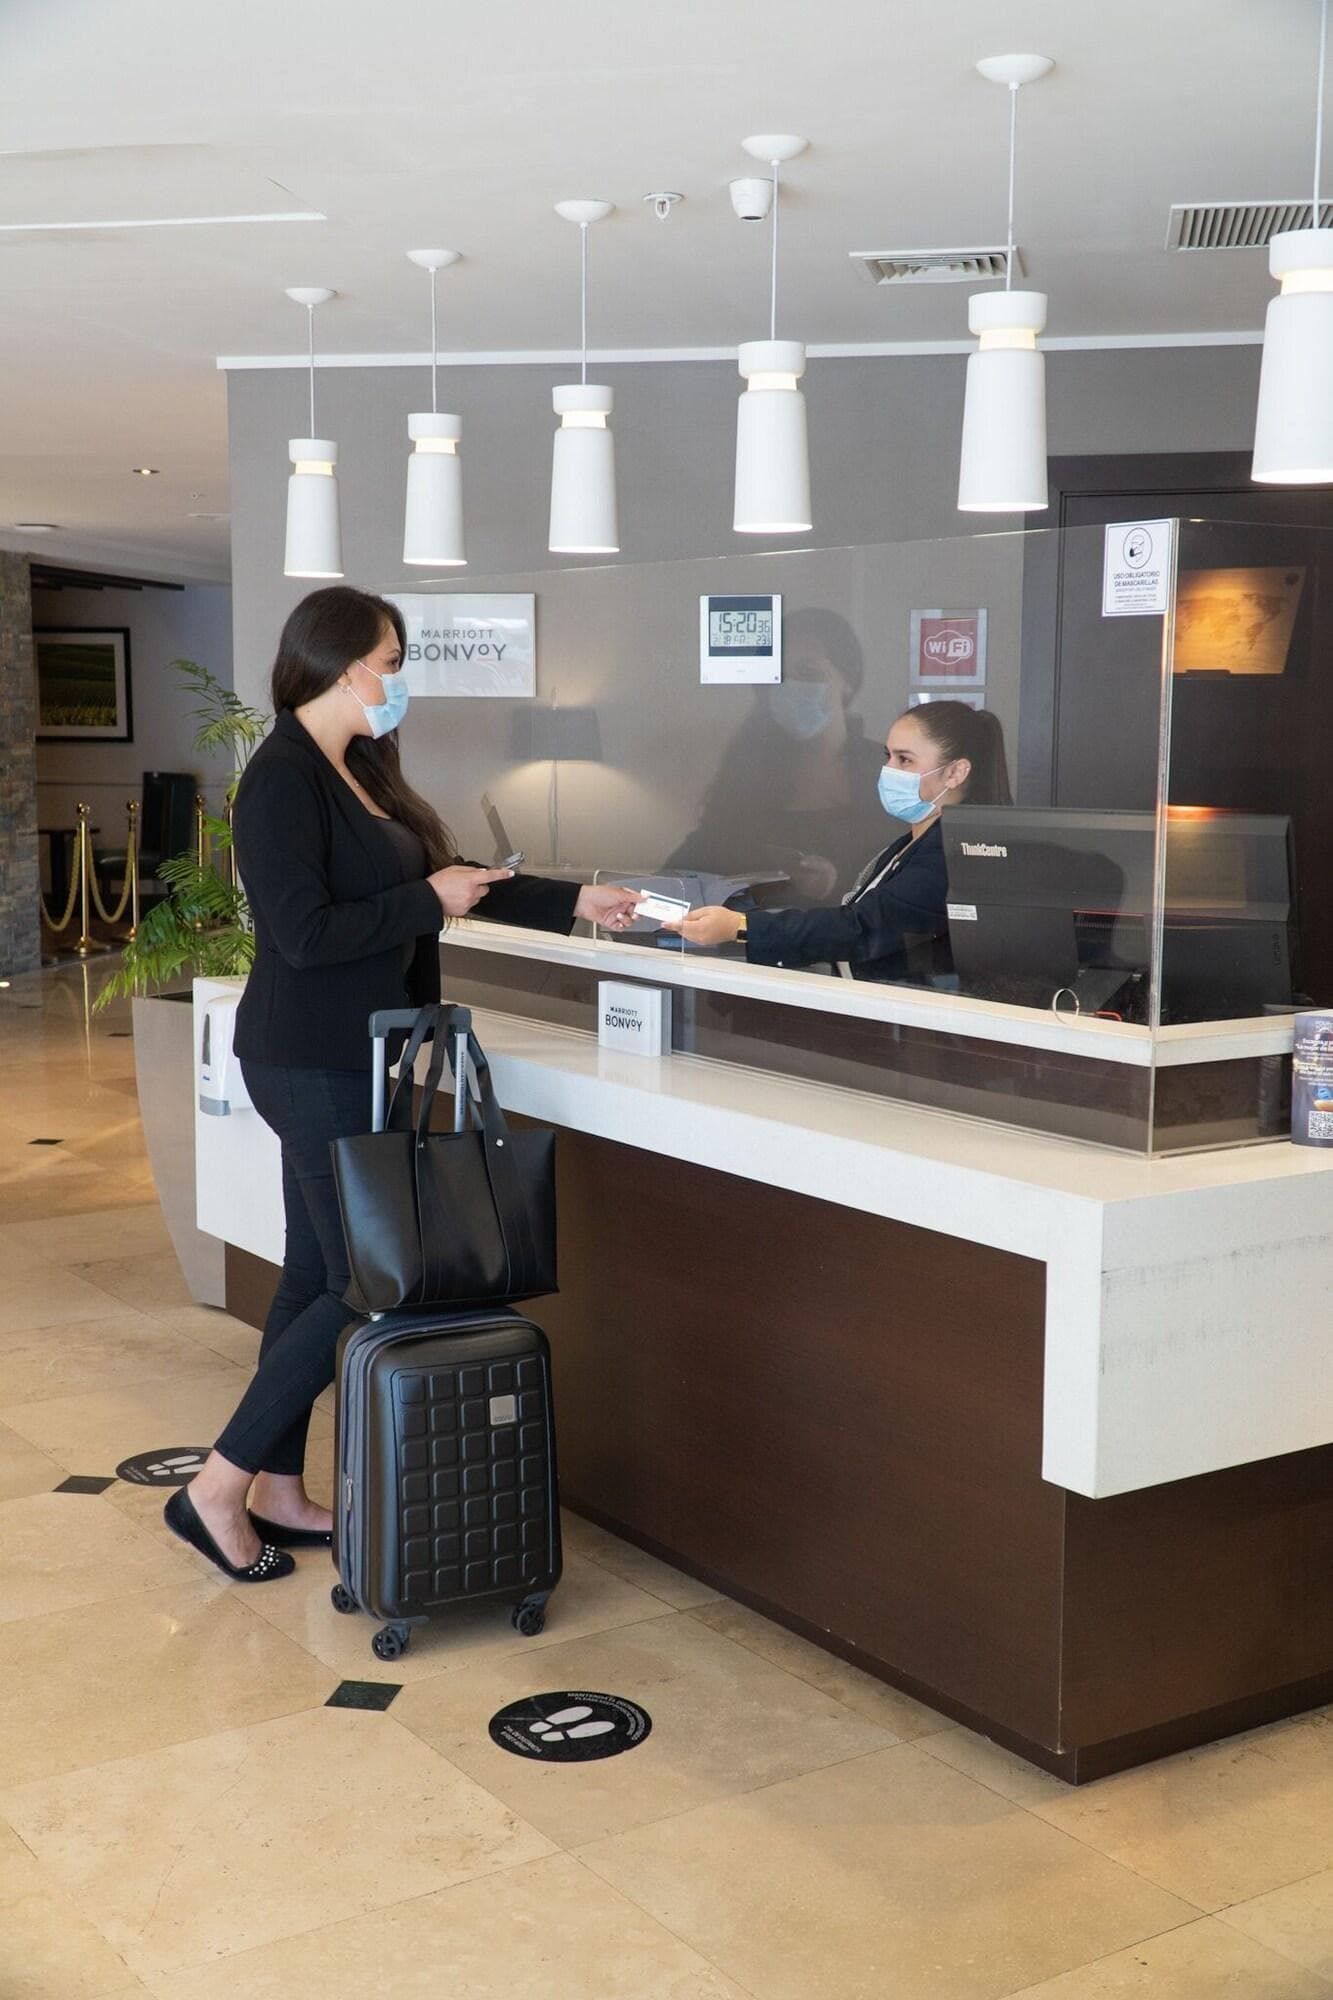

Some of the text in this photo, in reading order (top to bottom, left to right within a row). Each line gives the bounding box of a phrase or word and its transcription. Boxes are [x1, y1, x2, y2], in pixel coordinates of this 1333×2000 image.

[421, 629, 494, 639] MARRIOTT
[408, 644, 506, 661] BONVOY
[960, 842, 1008, 858] ThinkCentre
[610, 1006, 638, 1017] MARRIOTT
[605, 1013, 643, 1032] BONVOY
